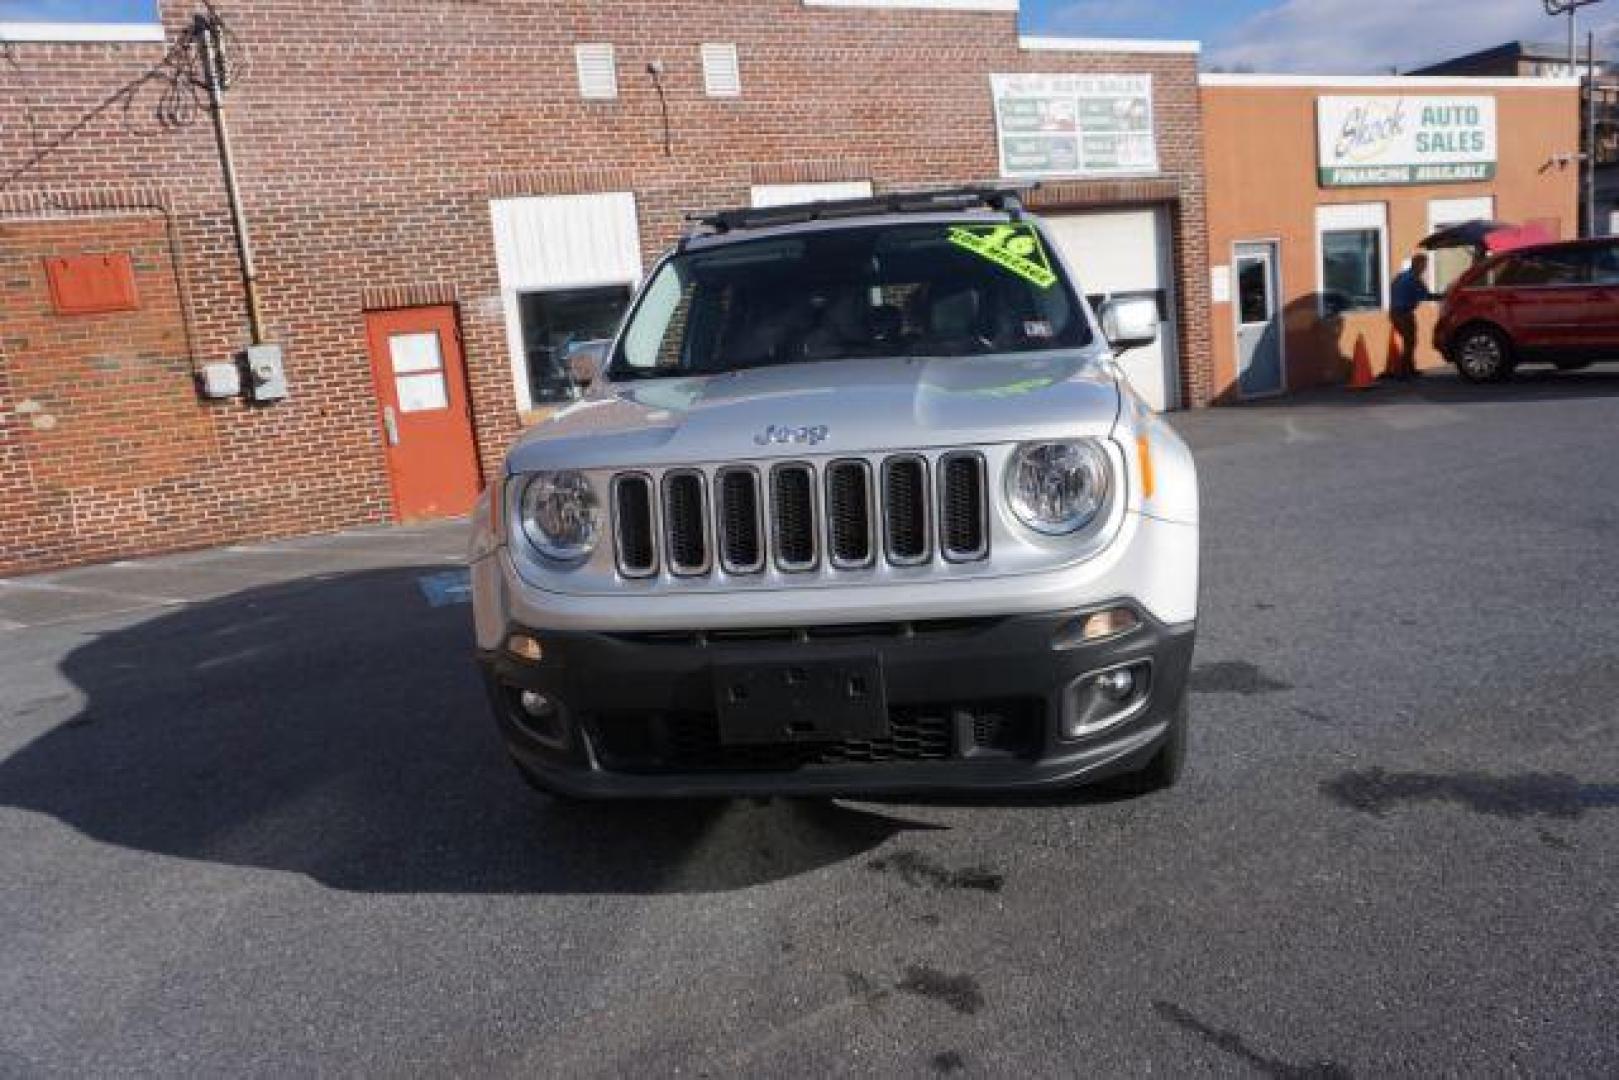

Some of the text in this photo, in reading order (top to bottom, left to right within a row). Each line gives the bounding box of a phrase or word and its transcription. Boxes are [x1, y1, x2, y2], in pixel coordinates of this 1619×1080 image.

[1421, 105, 1480, 125] AUTO
[1416, 131, 1485, 152] SALES
[753, 424, 828, 446] Jeep
